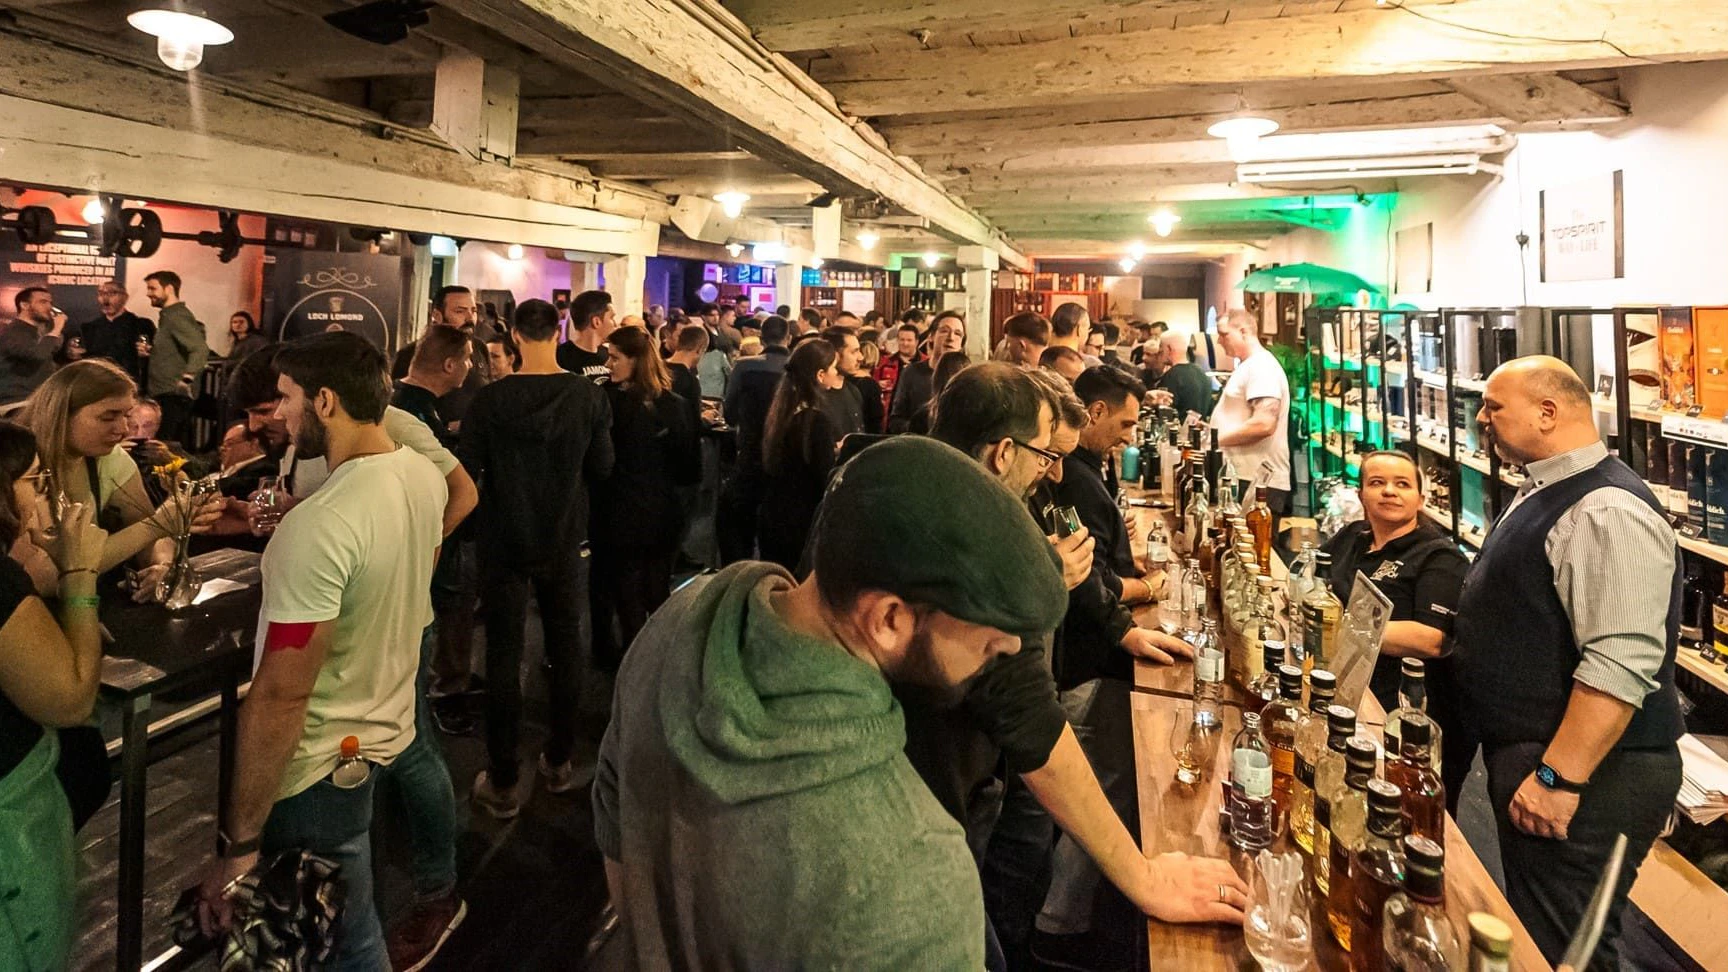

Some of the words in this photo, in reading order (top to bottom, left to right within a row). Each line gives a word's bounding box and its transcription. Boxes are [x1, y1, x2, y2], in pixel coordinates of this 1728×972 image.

[36, 253, 47, 263] OF
[48, 253, 95, 265] DISTINCTIVE
[53, 264, 94, 276] PRODUCED
[307, 312, 328, 320] LOCH
[330, 312, 363, 321] LOMOND
